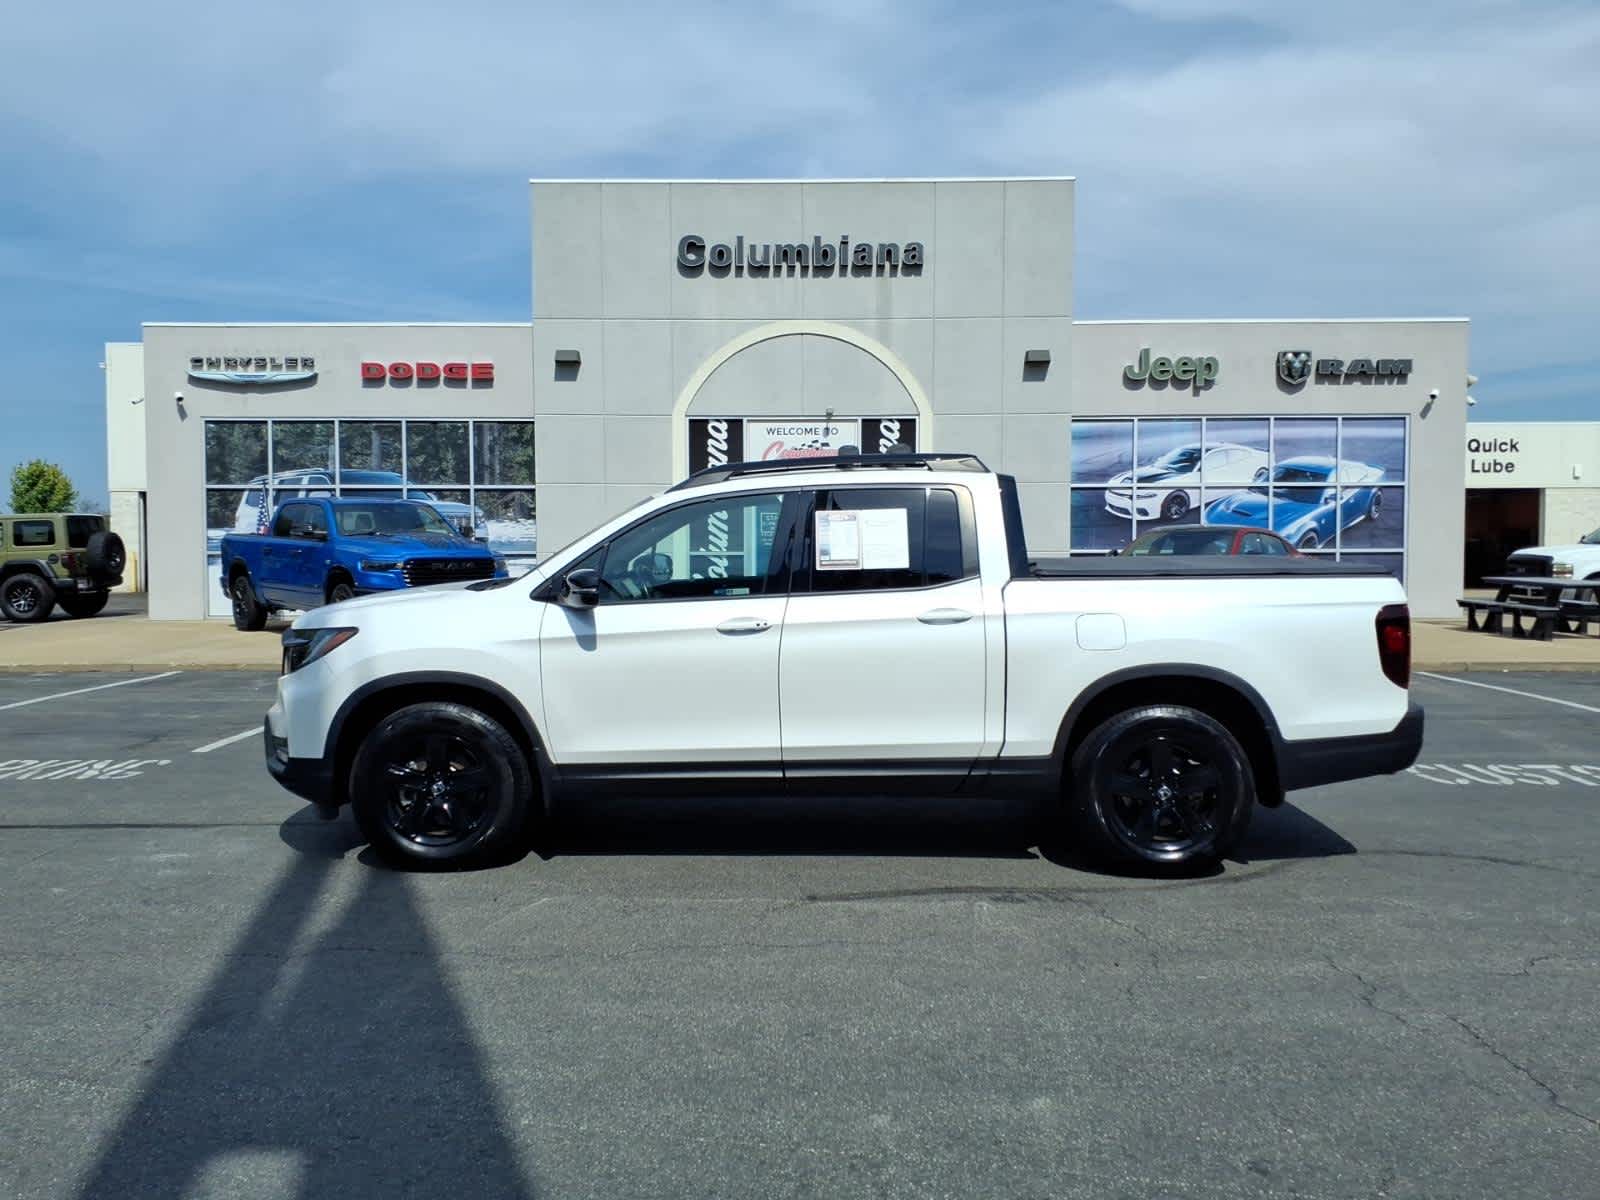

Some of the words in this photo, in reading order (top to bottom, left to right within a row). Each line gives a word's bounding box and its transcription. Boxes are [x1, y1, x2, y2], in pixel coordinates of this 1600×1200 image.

[677, 234, 925, 267] Columbiana
[190, 357, 315, 370] CHRYSLER
[361, 362, 494, 378] DODGE
[1123, 348, 1219, 386] Jeep
[1316, 359, 1413, 375] RAM
[766, 427, 820, 436] WELCOME
[1467, 438, 1520, 453] Quick
[1471, 459, 1515, 473] Lube
